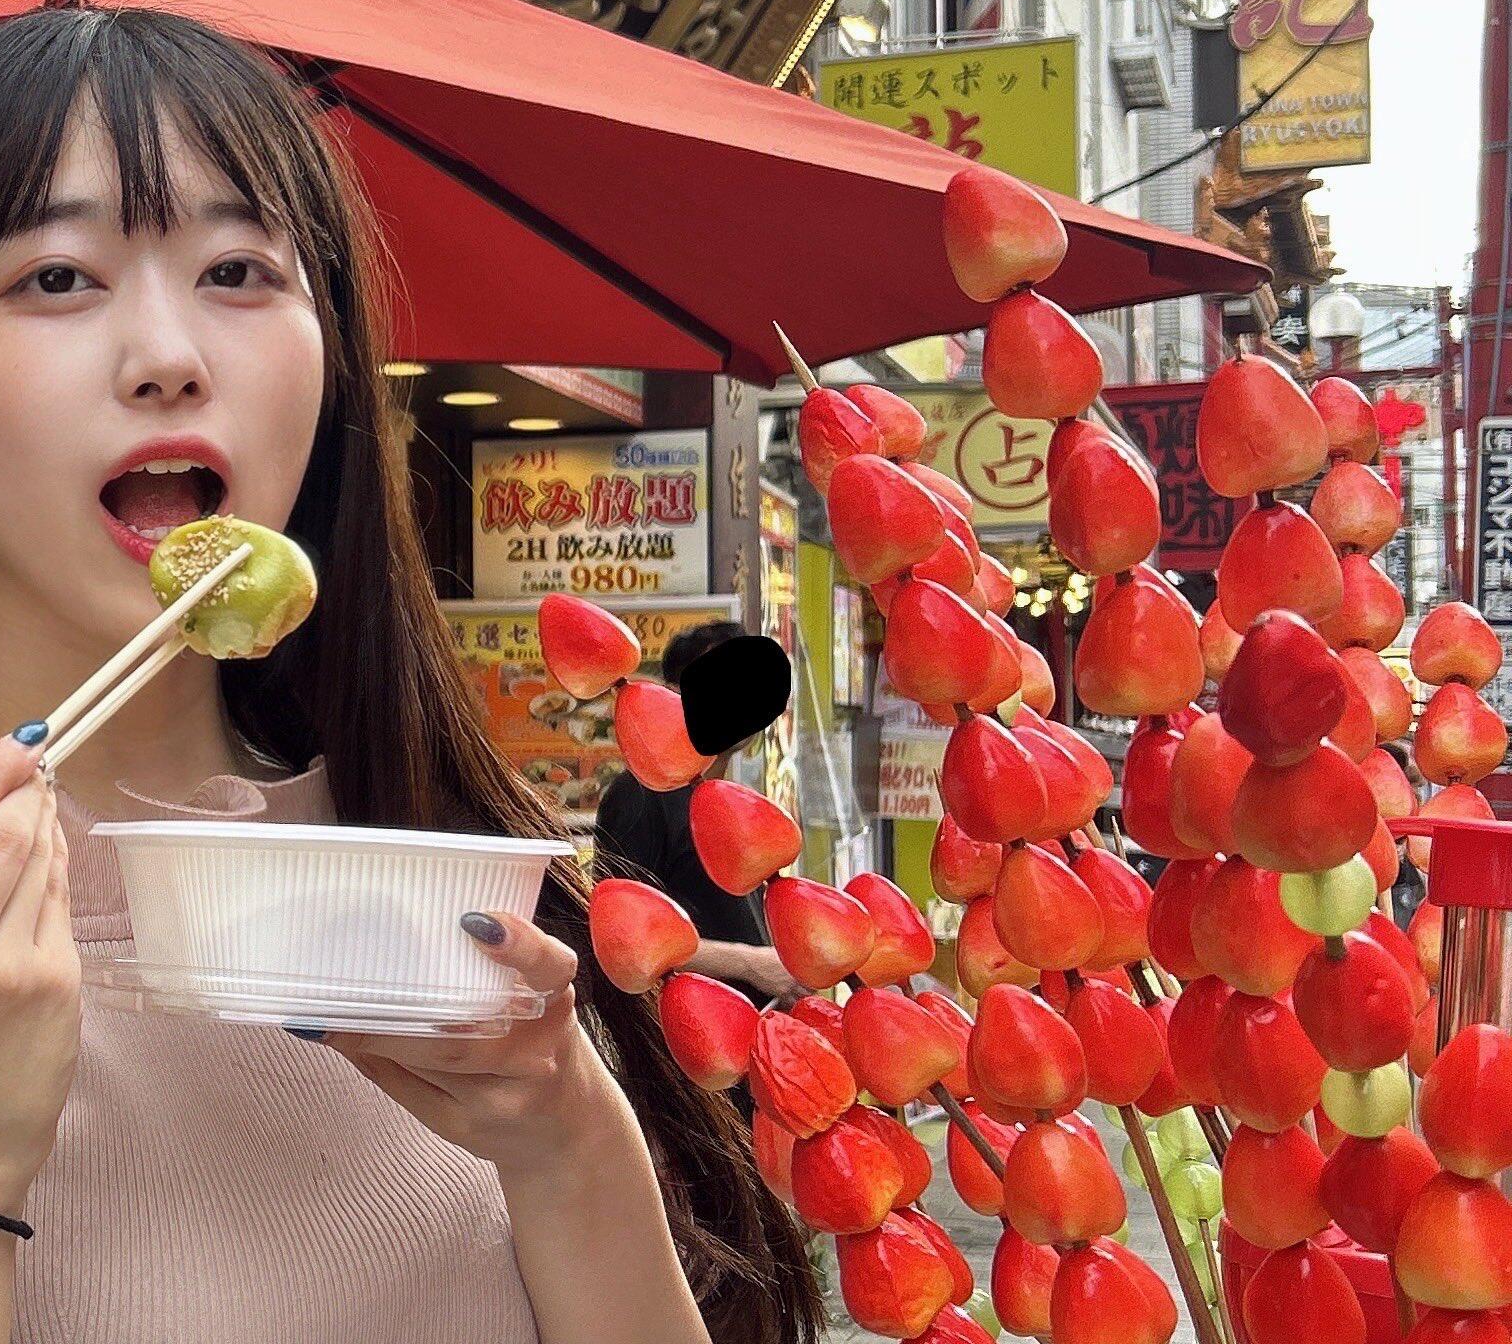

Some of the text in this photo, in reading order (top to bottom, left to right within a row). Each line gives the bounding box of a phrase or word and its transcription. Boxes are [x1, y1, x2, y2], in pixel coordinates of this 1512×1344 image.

[833, 57, 1060, 110] 開運スポット
[981, 420, 1044, 489] 占
[480, 471, 697, 534] 飲み放題
[556, 532, 676, 562] 飲み放題
[570, 564, 662, 594] 980円
